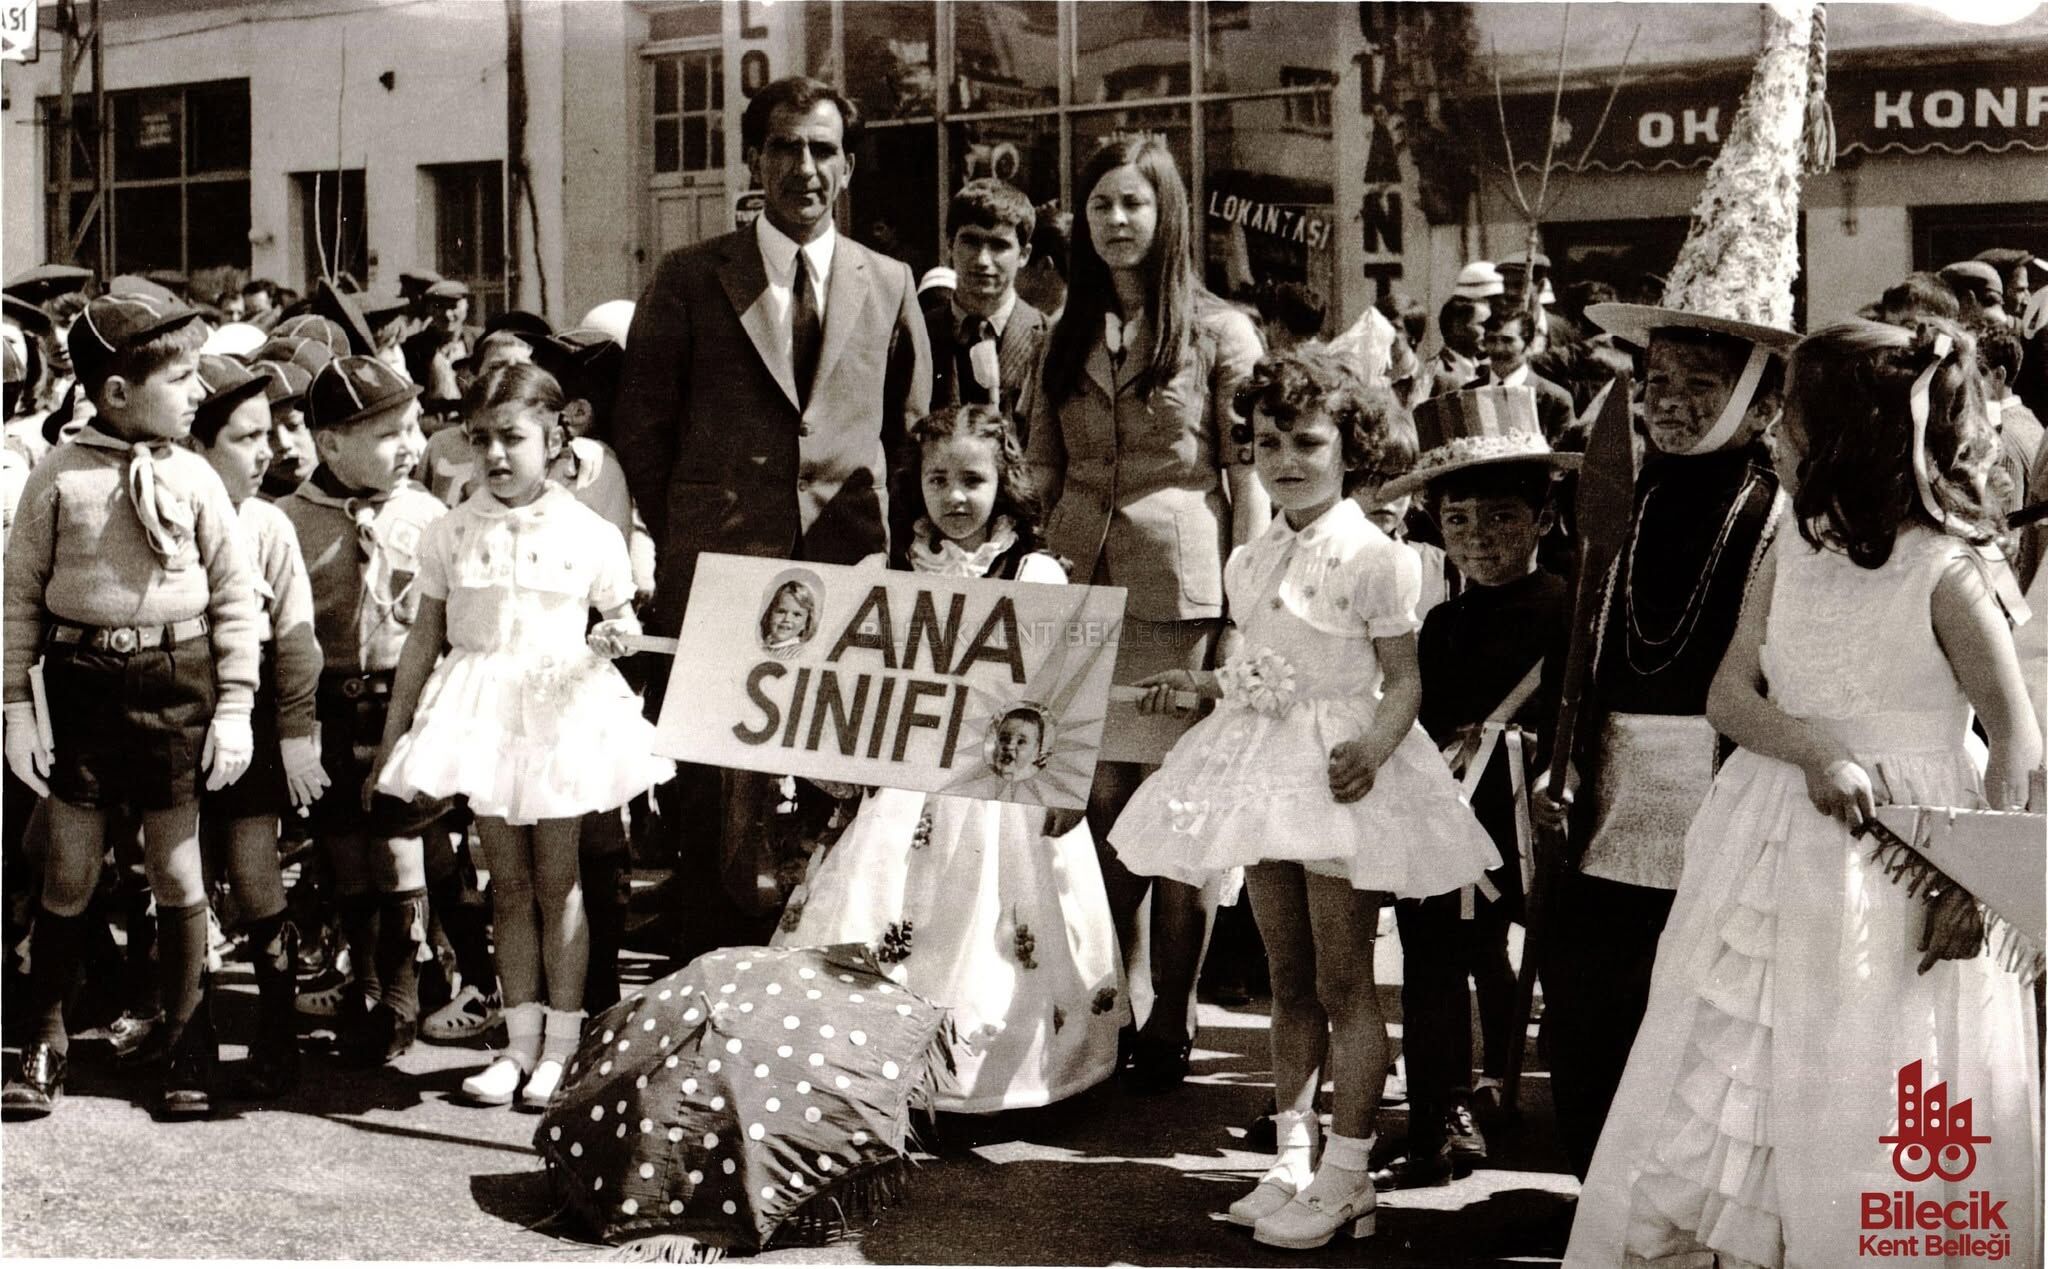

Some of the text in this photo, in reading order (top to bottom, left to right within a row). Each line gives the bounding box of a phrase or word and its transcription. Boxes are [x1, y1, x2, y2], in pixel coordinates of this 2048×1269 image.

[1209, 191, 1331, 250] LOKANTASI
[827, 585, 1026, 684] ANA
[732, 661, 968, 768] SINIFI
